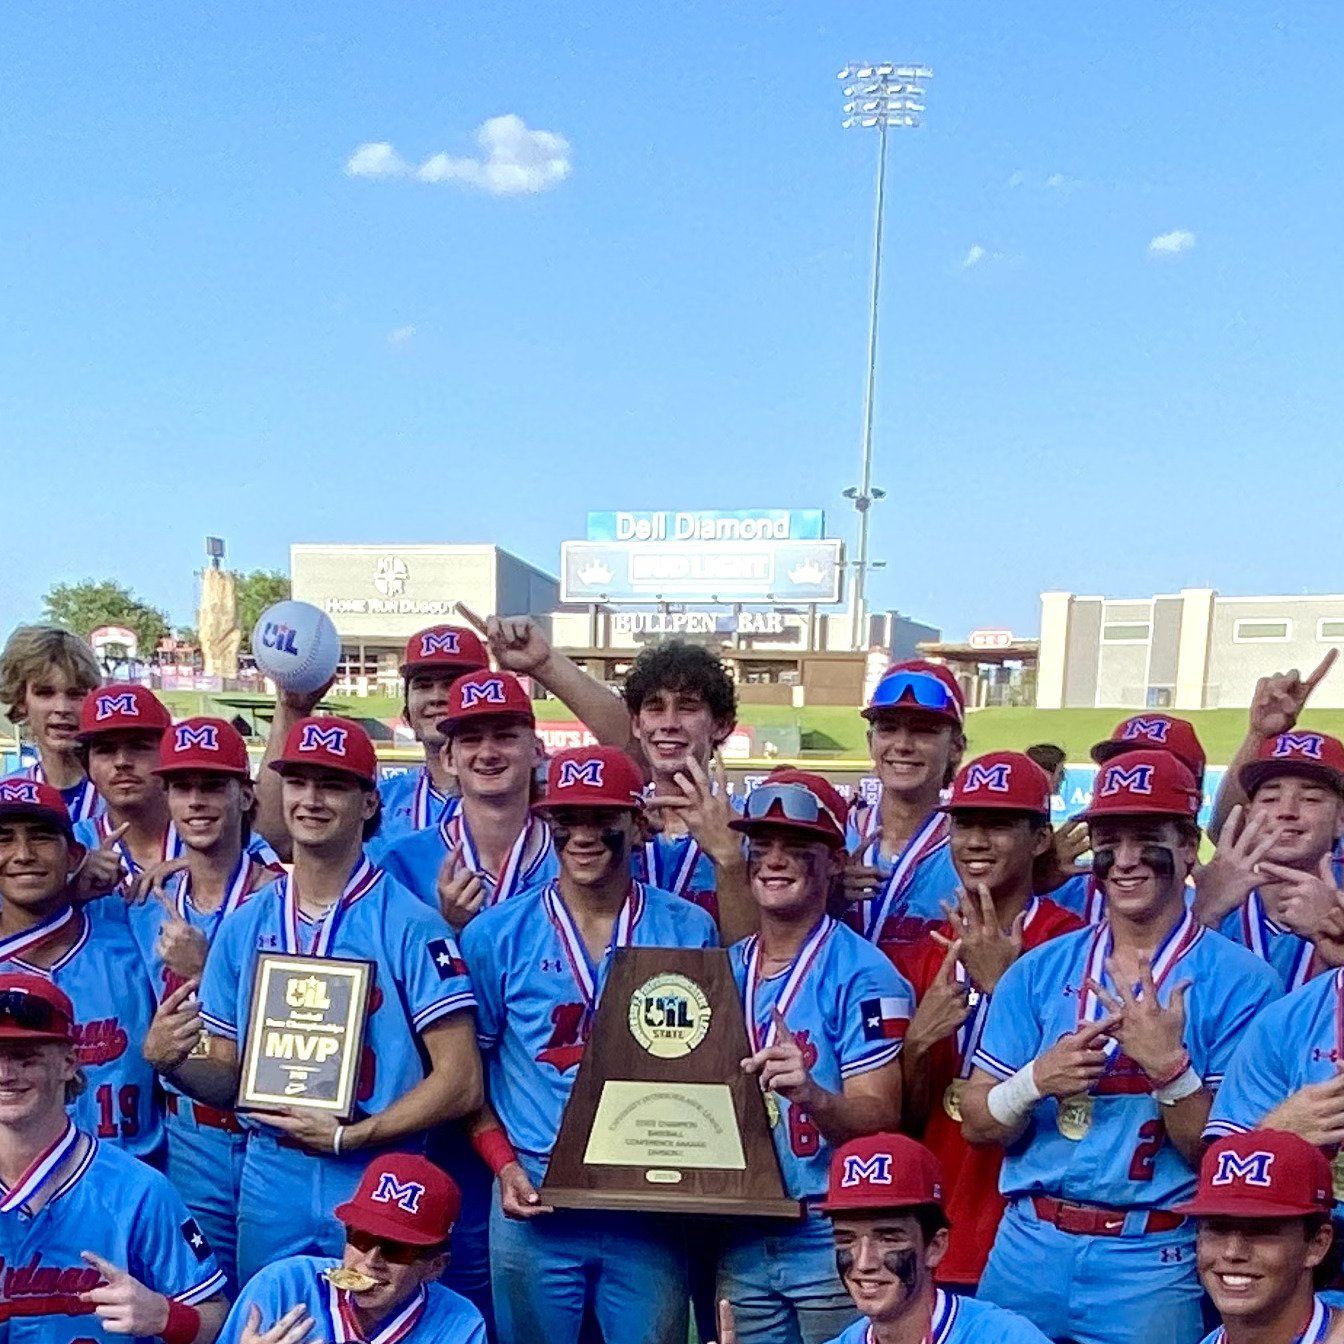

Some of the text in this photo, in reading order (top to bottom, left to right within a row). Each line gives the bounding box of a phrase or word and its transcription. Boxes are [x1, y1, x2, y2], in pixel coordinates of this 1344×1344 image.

[616, 511, 791, 540] Dell Diamond
[613, 612, 784, 633] BULLPEN BAR
[420, 631, 460, 657] M
[94, 692, 140, 721] M
[460, 679, 506, 710] M
[174, 723, 220, 753] M
[299, 724, 348, 756] M
[1123, 717, 1172, 743] M
[1271, 731, 1324, 760] M
[558, 759, 605, 789] M
[962, 763, 1012, 794] M
[1099, 763, 1155, 797] M
[265, 1032, 340, 1063] MVP
[652, 1030, 685, 1039] STATE
[96, 1083, 140, 1138] 19
[842, 1153, 893, 1186] M
[1212, 1150, 1275, 1187] M
[372, 1171, 426, 1214] M
